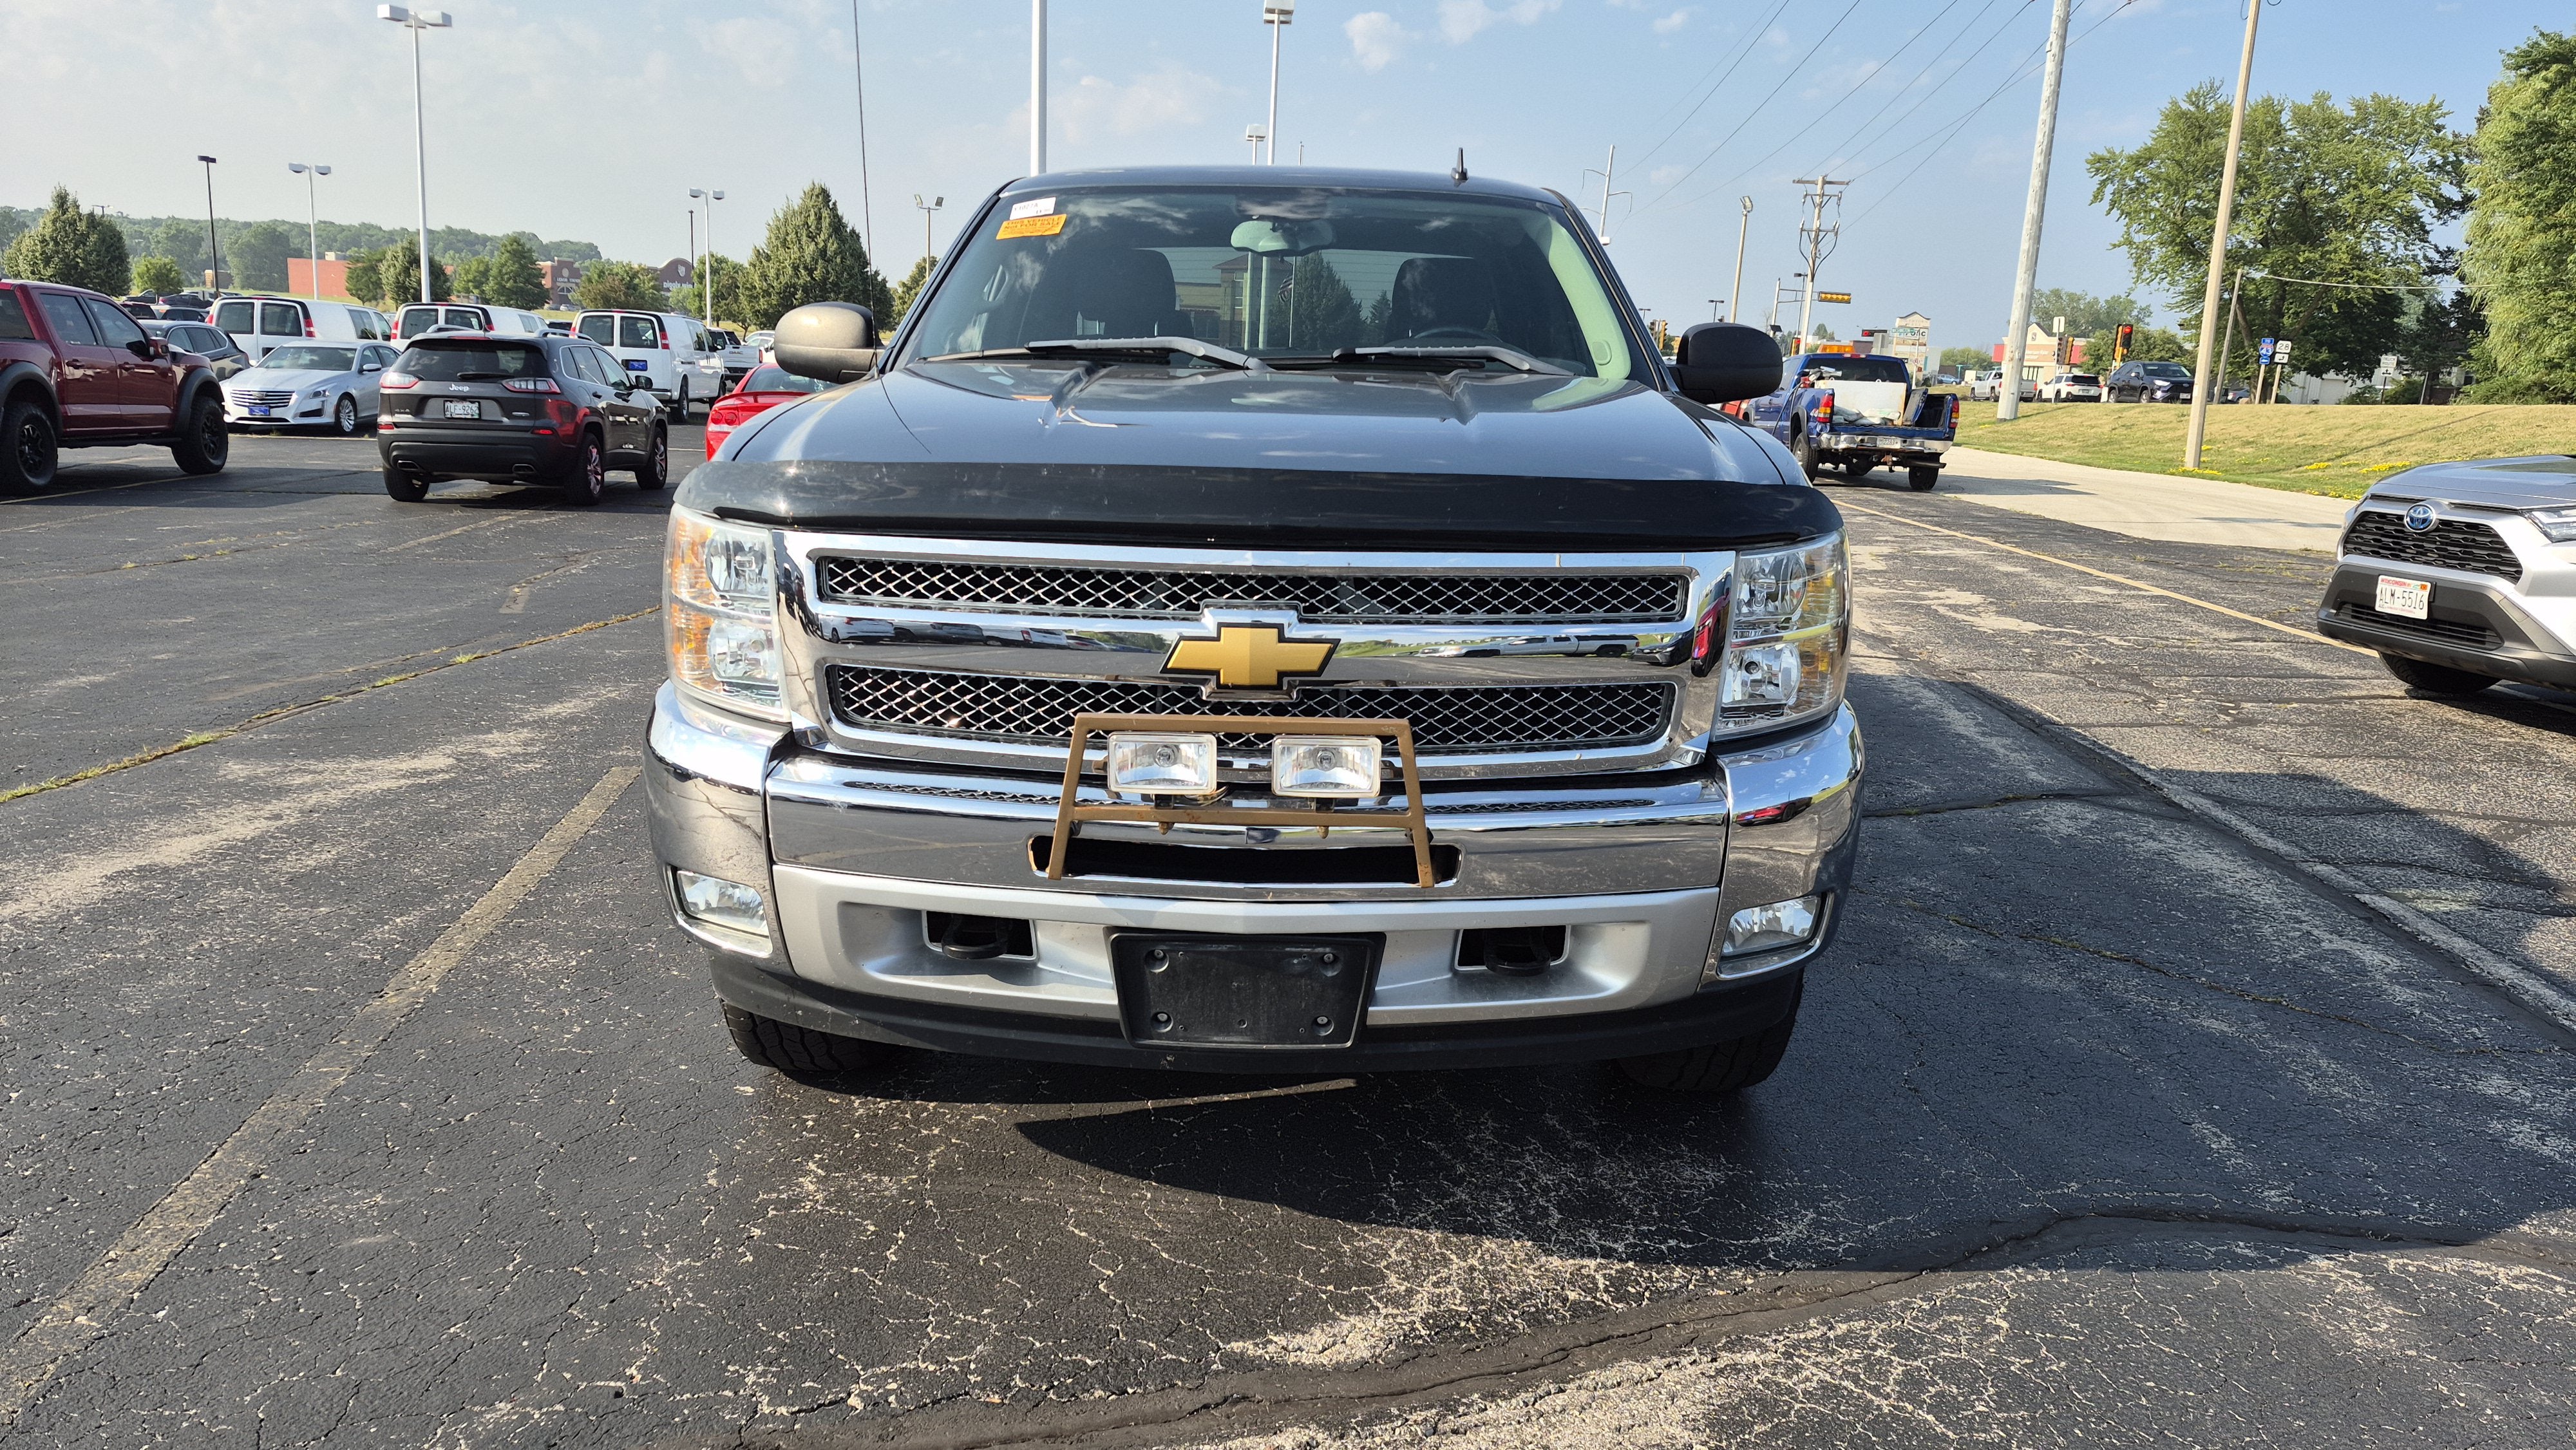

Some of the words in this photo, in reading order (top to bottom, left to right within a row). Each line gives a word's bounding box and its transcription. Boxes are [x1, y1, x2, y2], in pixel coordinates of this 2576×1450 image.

[449, 383, 470, 392] Jeep
[445, 404, 478, 415] ALF-9262
[2380, 578, 2407, 587] WISCONSIN
[2379, 587, 2425, 610] ALM-5516
